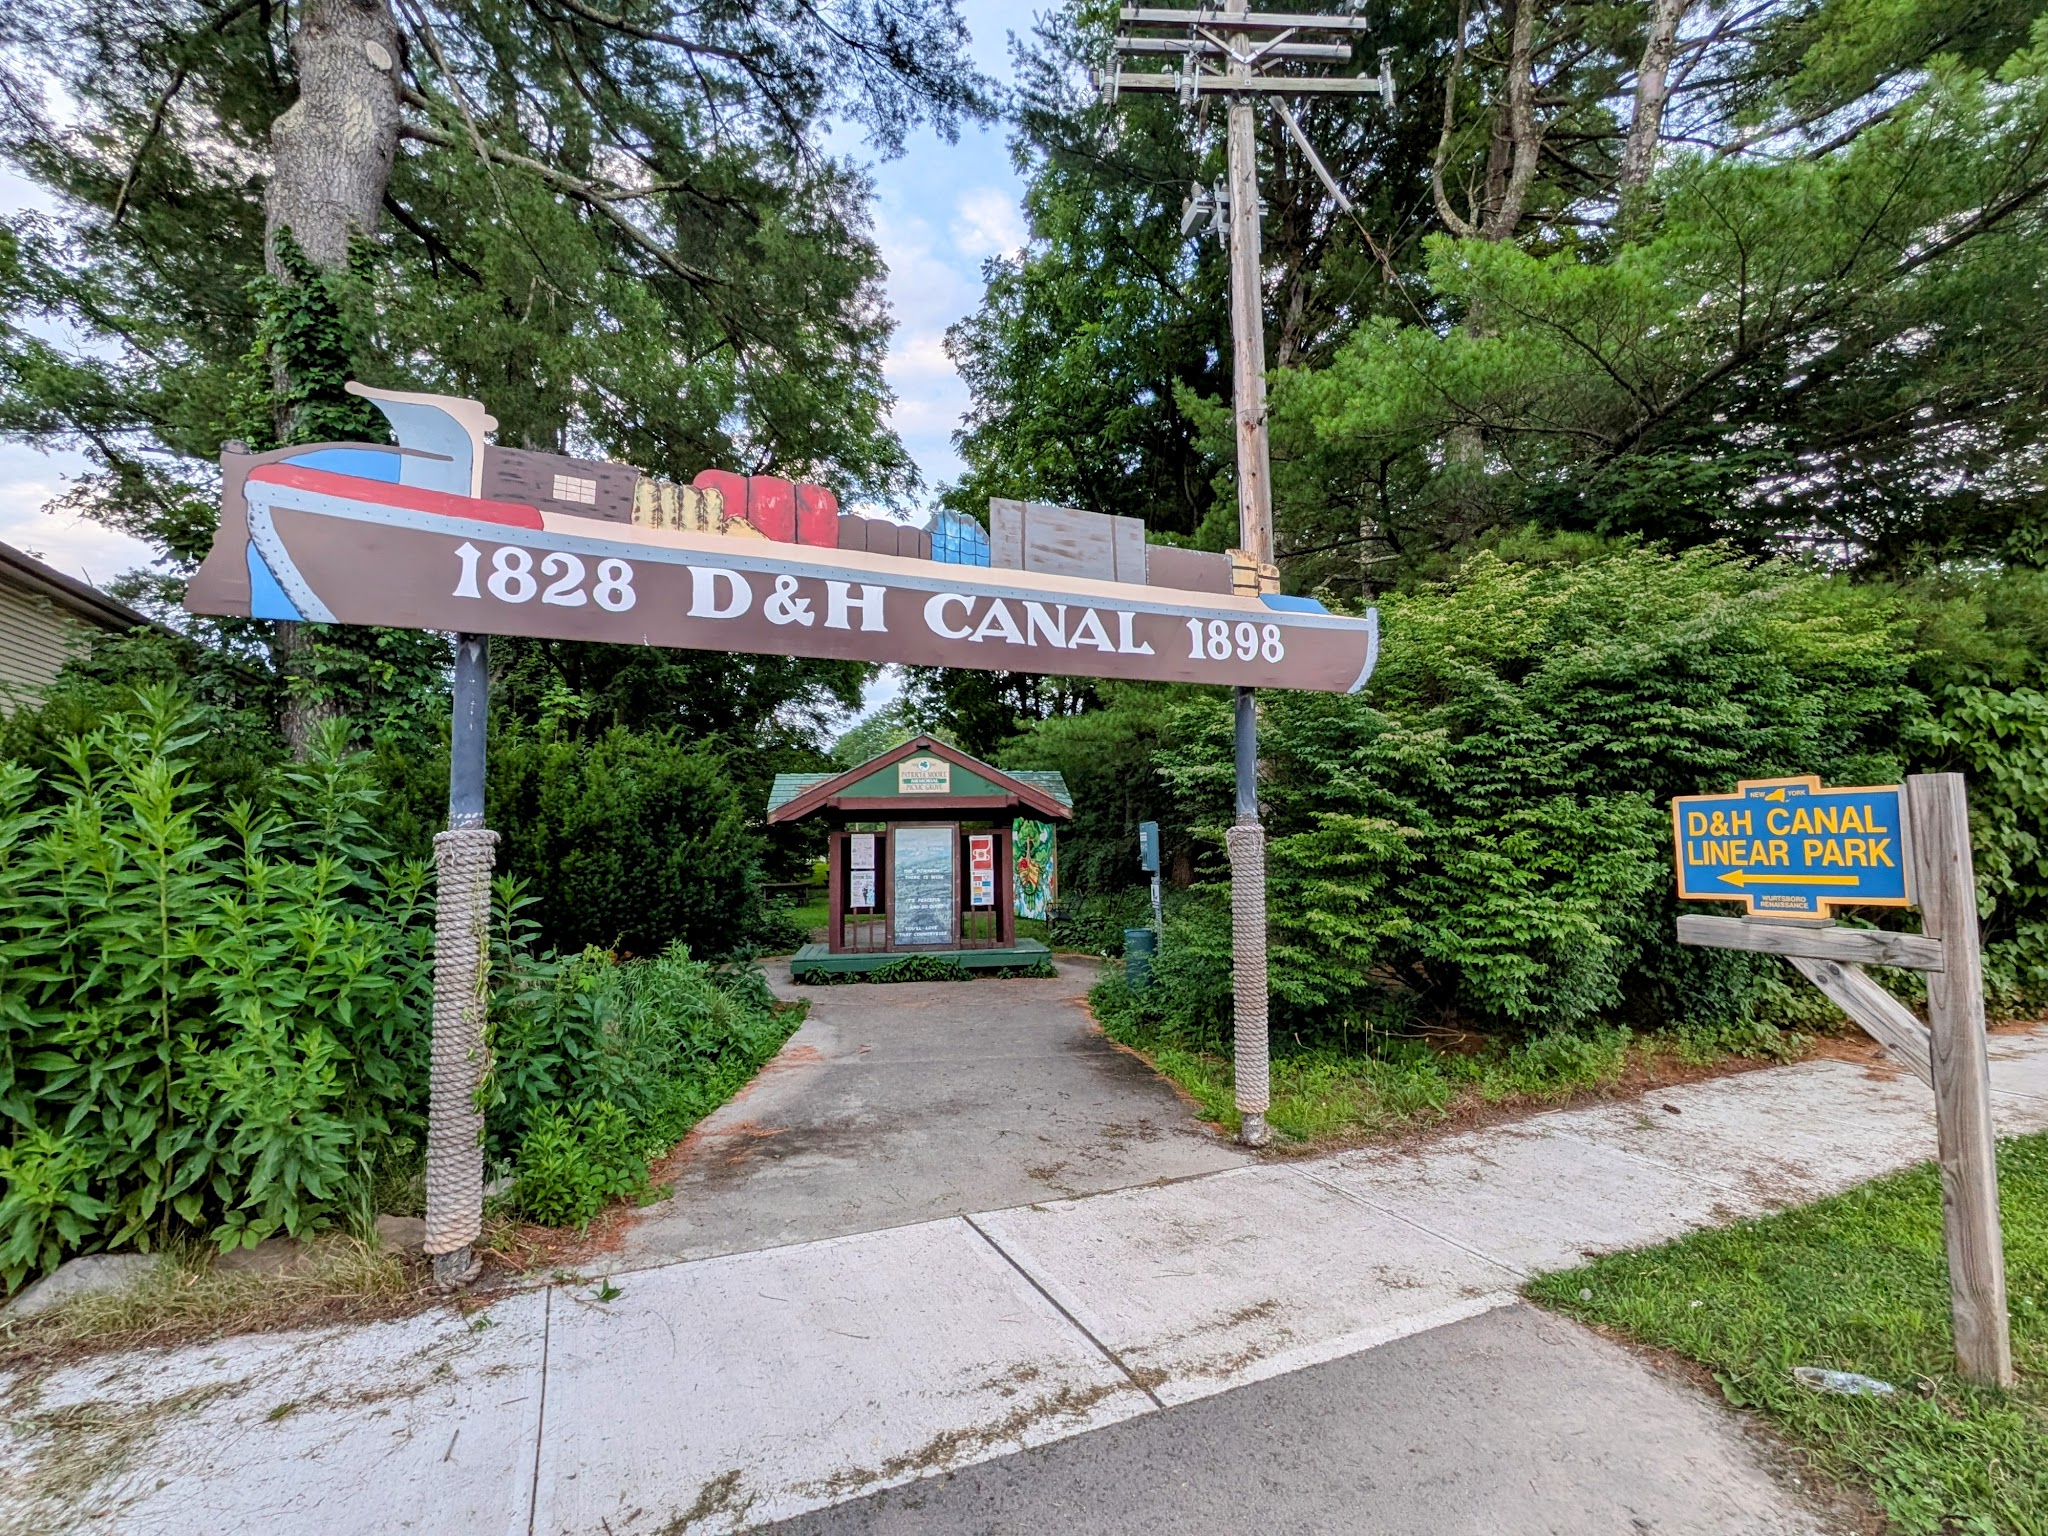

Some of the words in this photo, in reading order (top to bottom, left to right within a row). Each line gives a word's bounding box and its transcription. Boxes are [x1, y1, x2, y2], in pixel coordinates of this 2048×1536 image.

[452, 541, 637, 612] 1828
[686, 566, 888, 634] D&H
[924, 593, 1155, 656] CANAL
[1186, 617, 1286, 663] 1898
[1750, 791, 1765, 799] NEW
[1787, 789, 1806, 797] YORK
[1688, 809, 1753, 837] D&H
[1766, 805, 1888, 836] CANAL
[1687, 839, 1790, 866] LINEAR
[1803, 838, 1896, 867] PARK
[1760, 901, 1809, 910] RENAISSANCE
[1762, 895, 1807, 903] WURTSBORO
